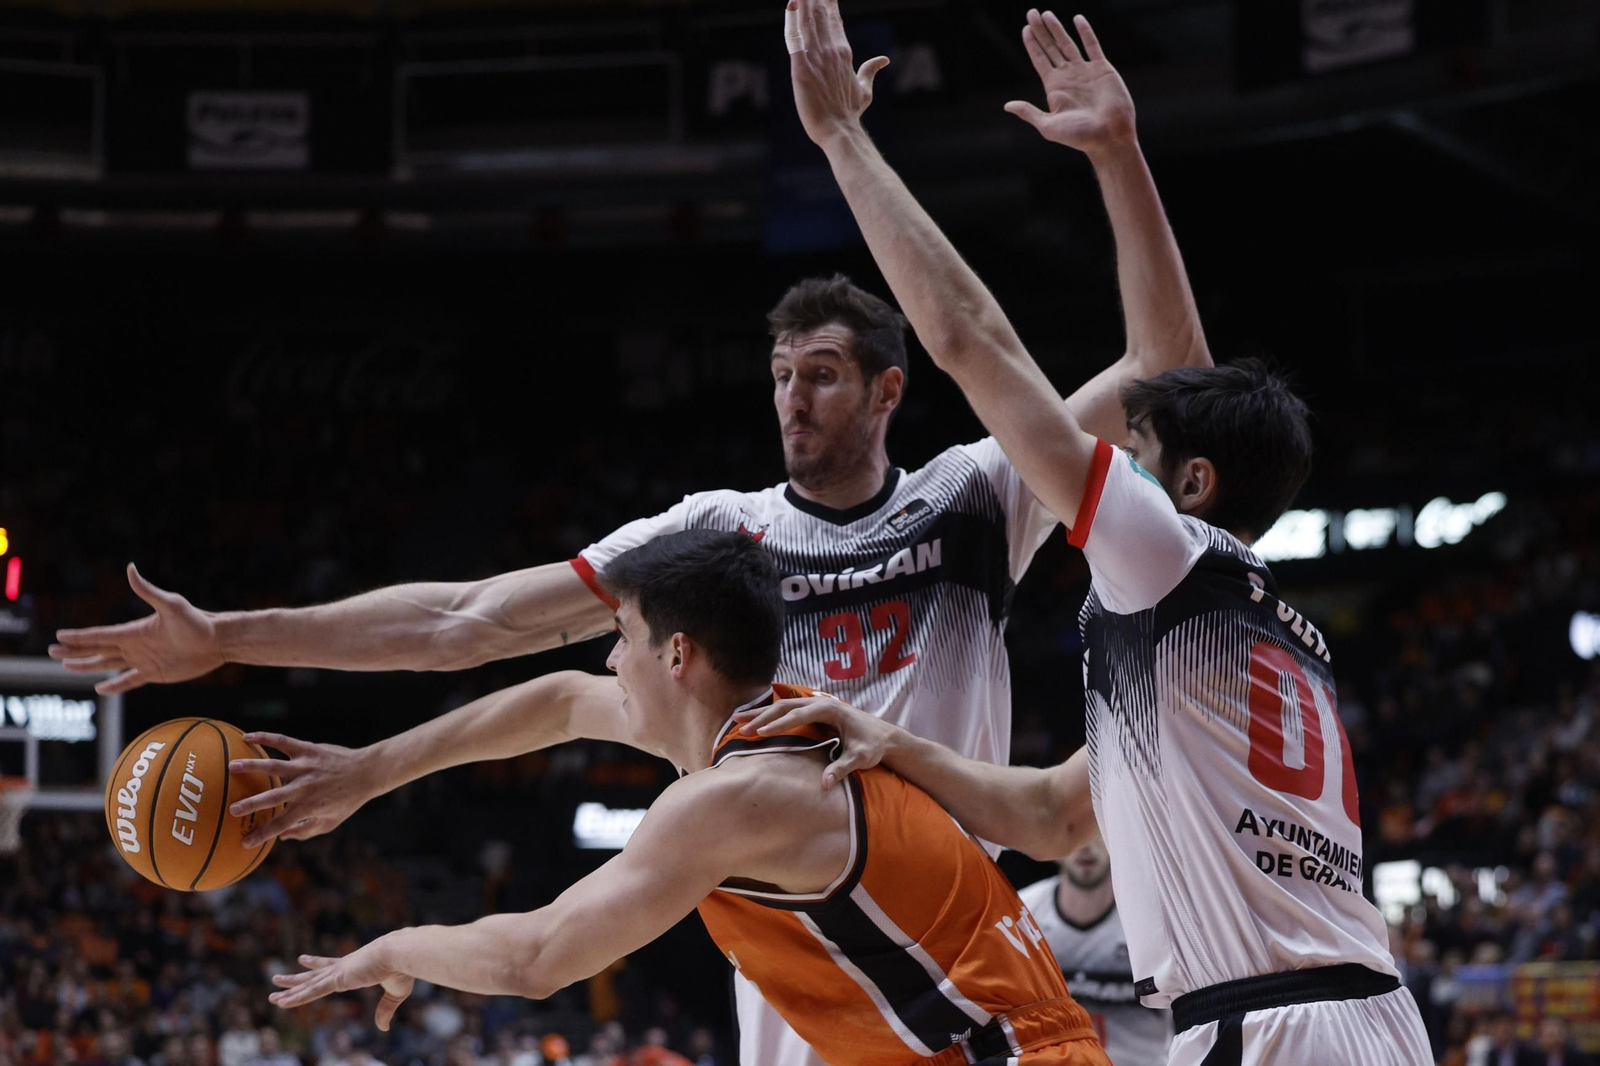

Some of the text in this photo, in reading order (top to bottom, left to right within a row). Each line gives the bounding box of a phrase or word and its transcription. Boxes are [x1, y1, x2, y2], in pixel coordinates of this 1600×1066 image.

[780, 538, 942, 601] OVIRAN
[818, 600, 917, 681] 32
[116, 741, 166, 853] Wilson
[171, 751, 205, 846] EVO NXT
[1255, 850, 1293, 878] DE
